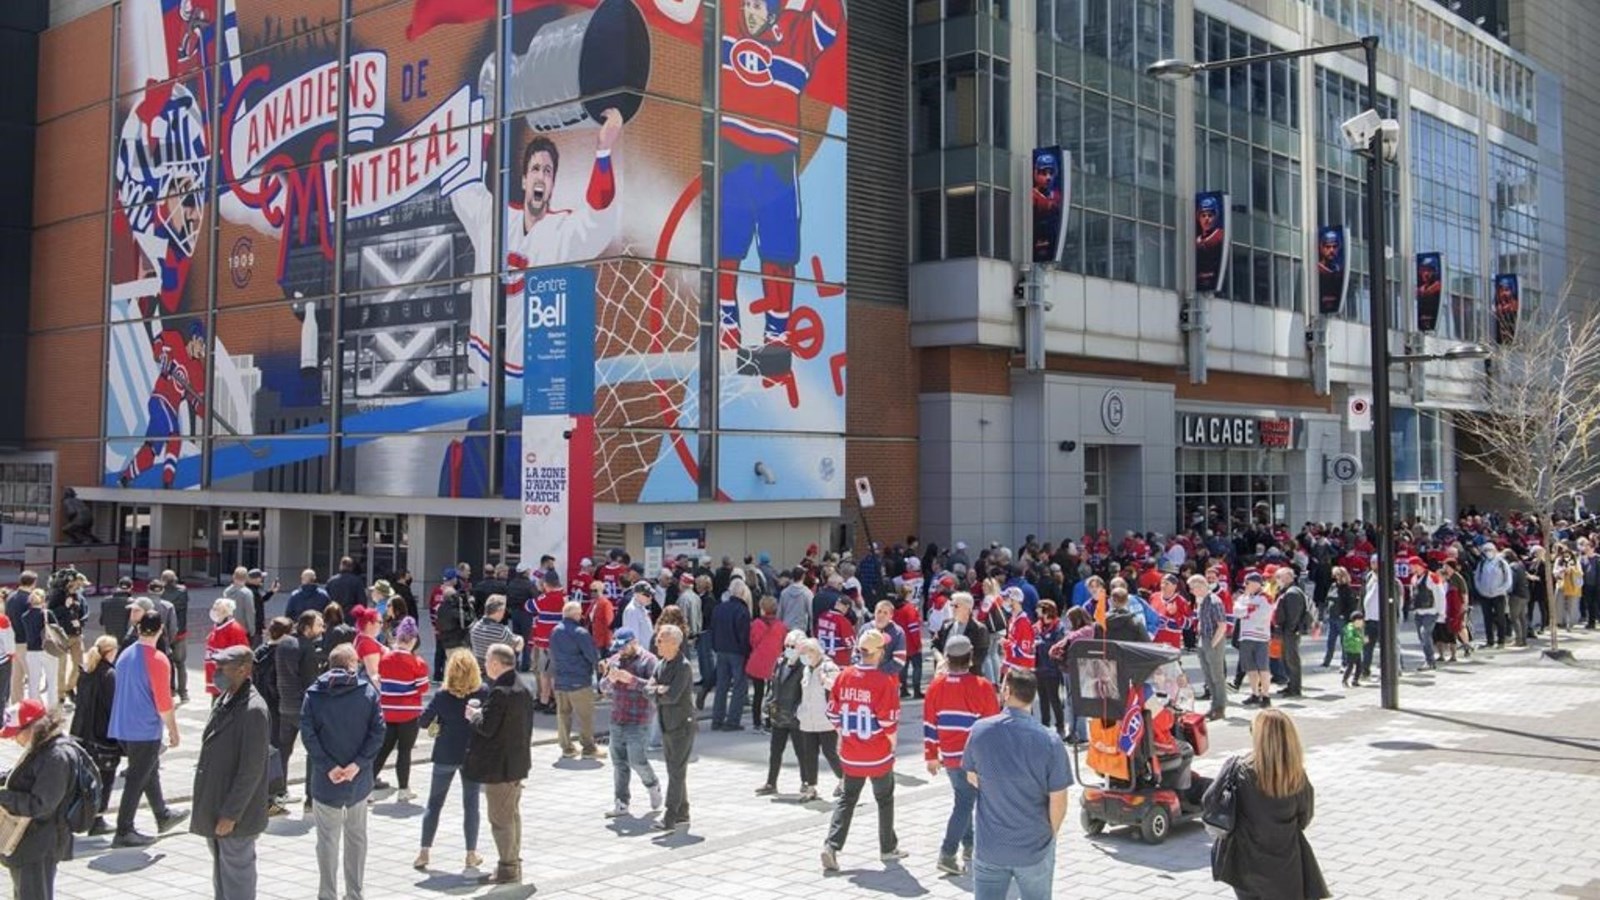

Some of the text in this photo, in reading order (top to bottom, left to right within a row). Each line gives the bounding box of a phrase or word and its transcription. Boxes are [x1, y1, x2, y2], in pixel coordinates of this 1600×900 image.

[402, 60, 428, 102] DE
[228, 252, 254, 269] 1909
[528, 276, 567, 294] Centre
[528, 293, 566, 328] Bell
[1185, 416, 1206, 443] LA
[1209, 418, 1254, 444] CAGE
[525, 467, 566, 478] LA ZONE
[525, 479, 566, 491] D'AVANT
[525, 491, 560, 503] MATCH
[840, 687, 872, 704] LAFLEUR
[840, 702, 872, 740] 10
